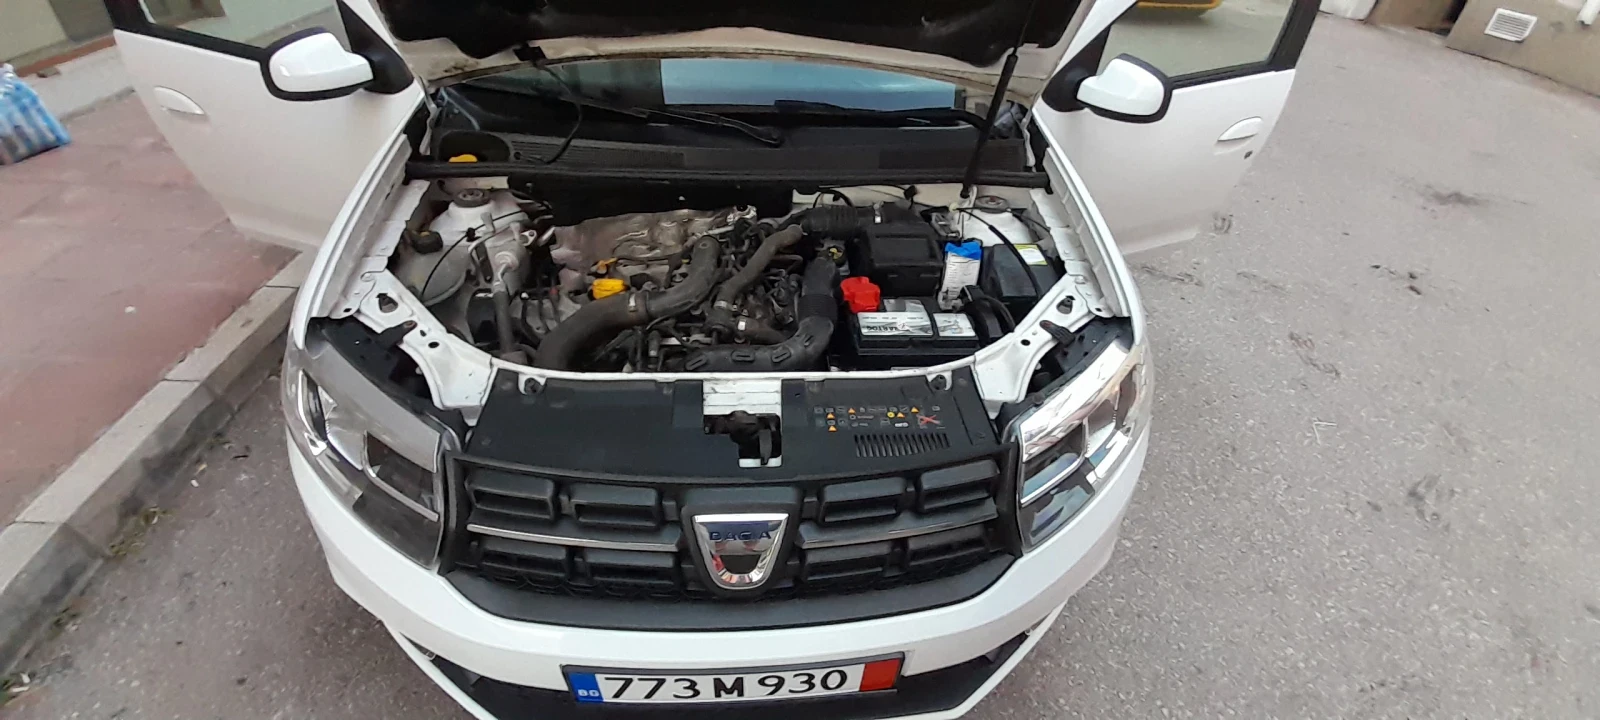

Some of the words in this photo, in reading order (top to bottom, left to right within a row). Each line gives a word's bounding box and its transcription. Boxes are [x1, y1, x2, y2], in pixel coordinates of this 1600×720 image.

[709, 531, 772, 541] DACA
[604, 677, 701, 699] 773
[713, 676, 745, 697] M
[757, 669, 848, 696] 930
[577, 689, 600, 697] BG
